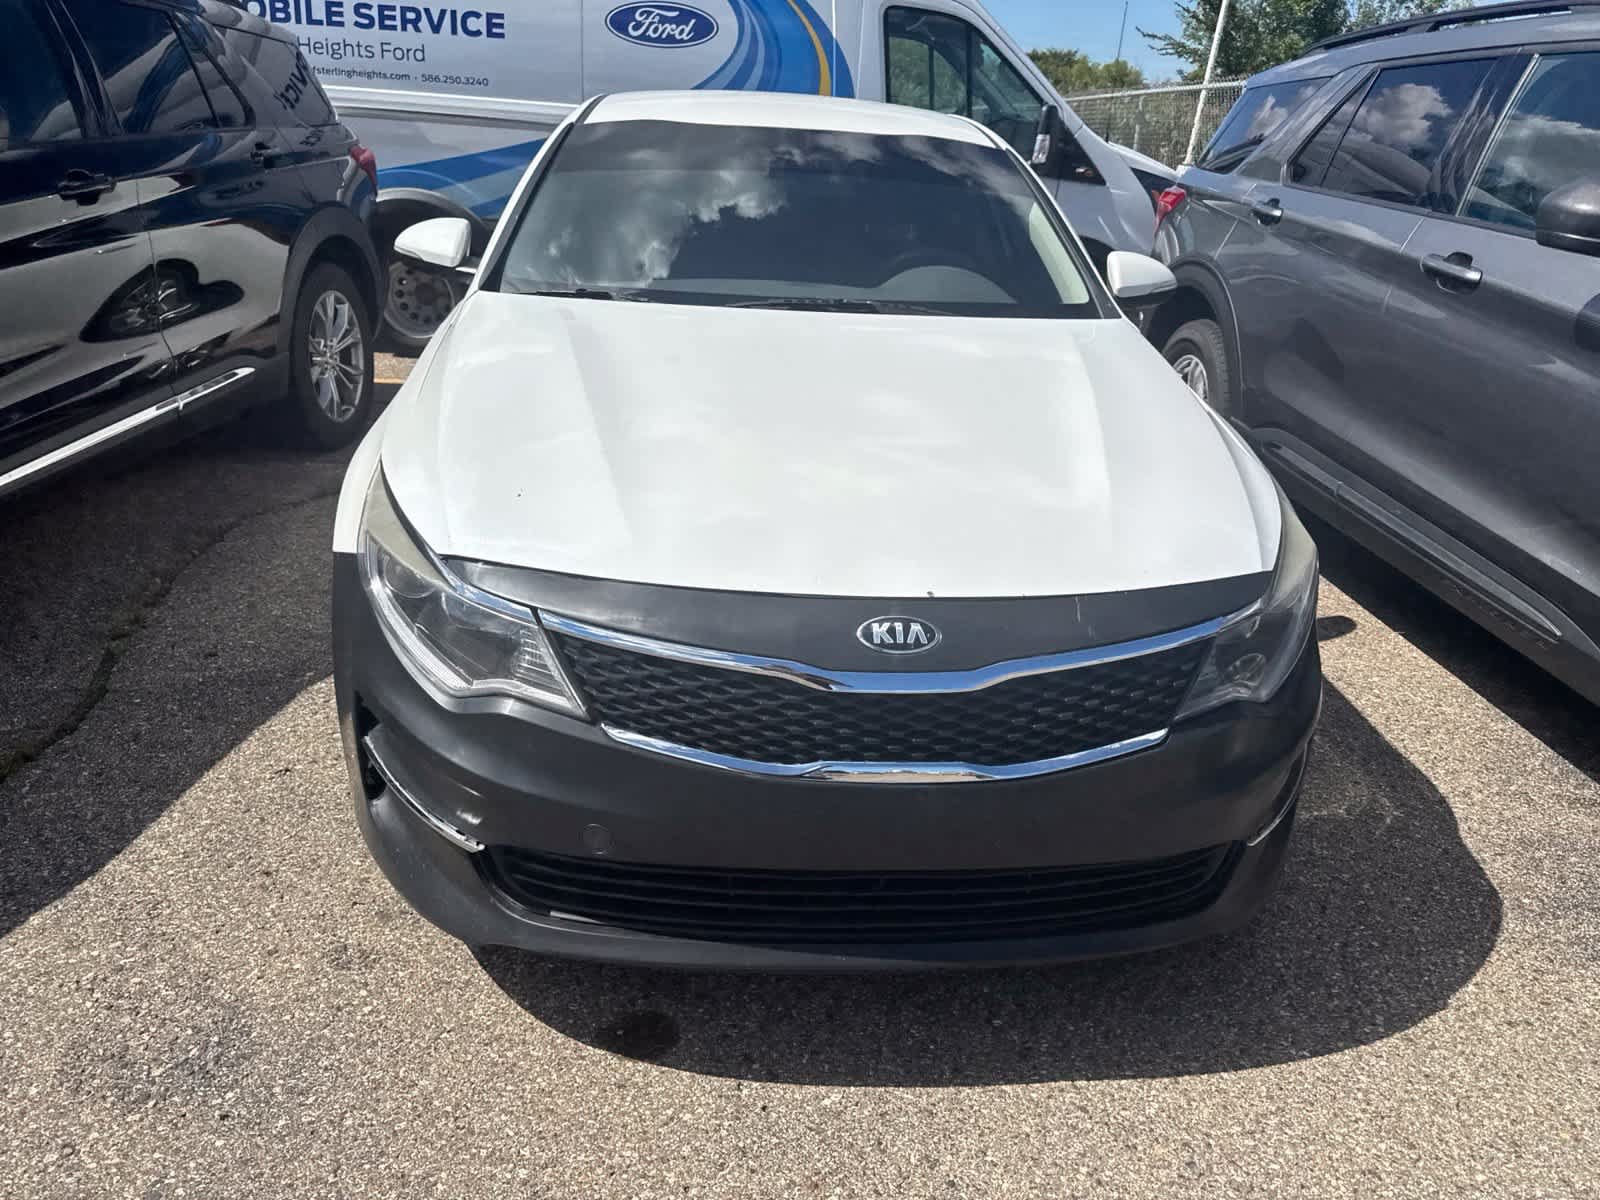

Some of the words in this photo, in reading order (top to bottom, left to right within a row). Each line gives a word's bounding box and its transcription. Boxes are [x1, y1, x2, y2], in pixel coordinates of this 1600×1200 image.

[353, 2, 506, 39] SERVICE
[628, 7, 697, 41] Ford
[298, 35, 375, 60] Heights
[380, 42, 425, 62] Ford
[421, 73, 489, 87] 586.250.3240
[871, 622, 928, 644] KIA
